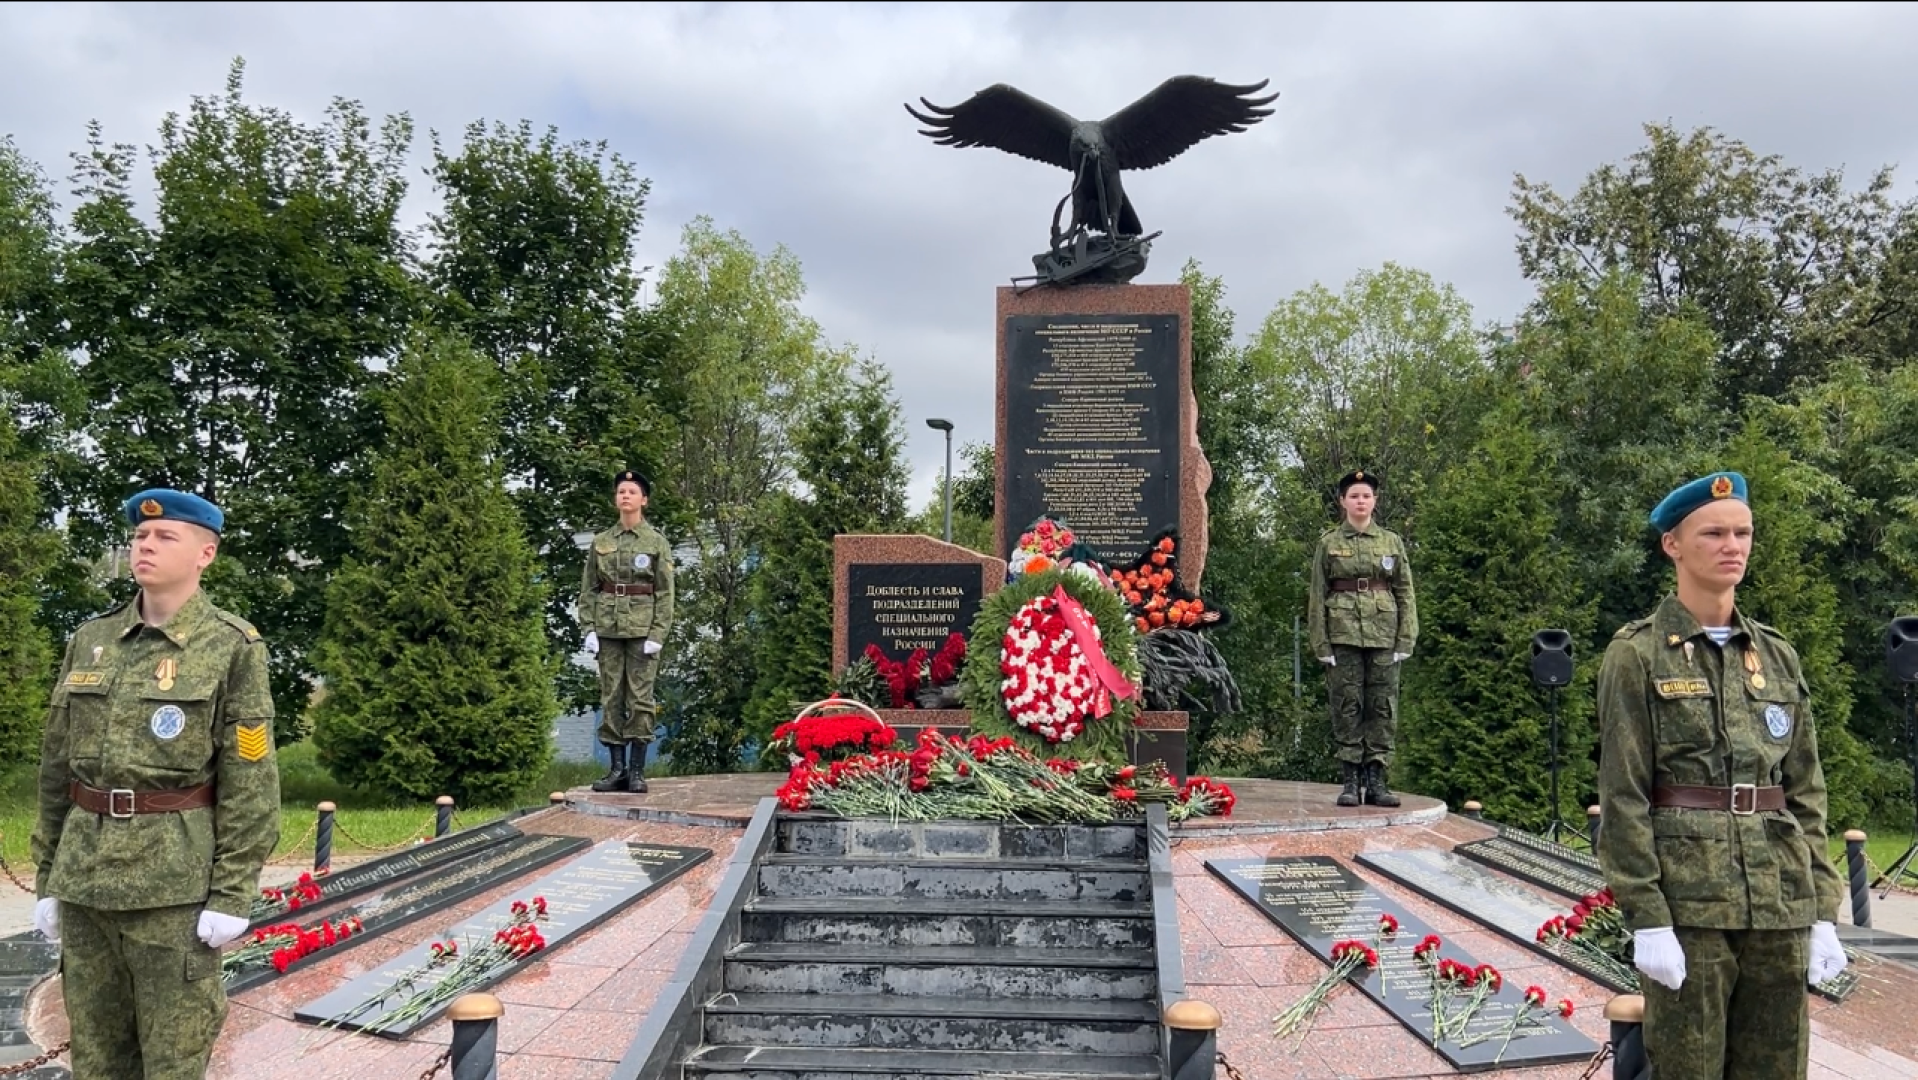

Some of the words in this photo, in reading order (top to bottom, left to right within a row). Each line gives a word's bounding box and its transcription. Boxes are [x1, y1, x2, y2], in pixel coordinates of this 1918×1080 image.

[931, 586, 965, 596] СЛАВА
[873, 597, 960, 609] ПОДРАЗДЕЛЕНИЙ
[875, 613, 956, 623] СПЕЦИАЛЬНОГО
[882, 627, 949, 636] НАЗНАЧЕНИЯ
